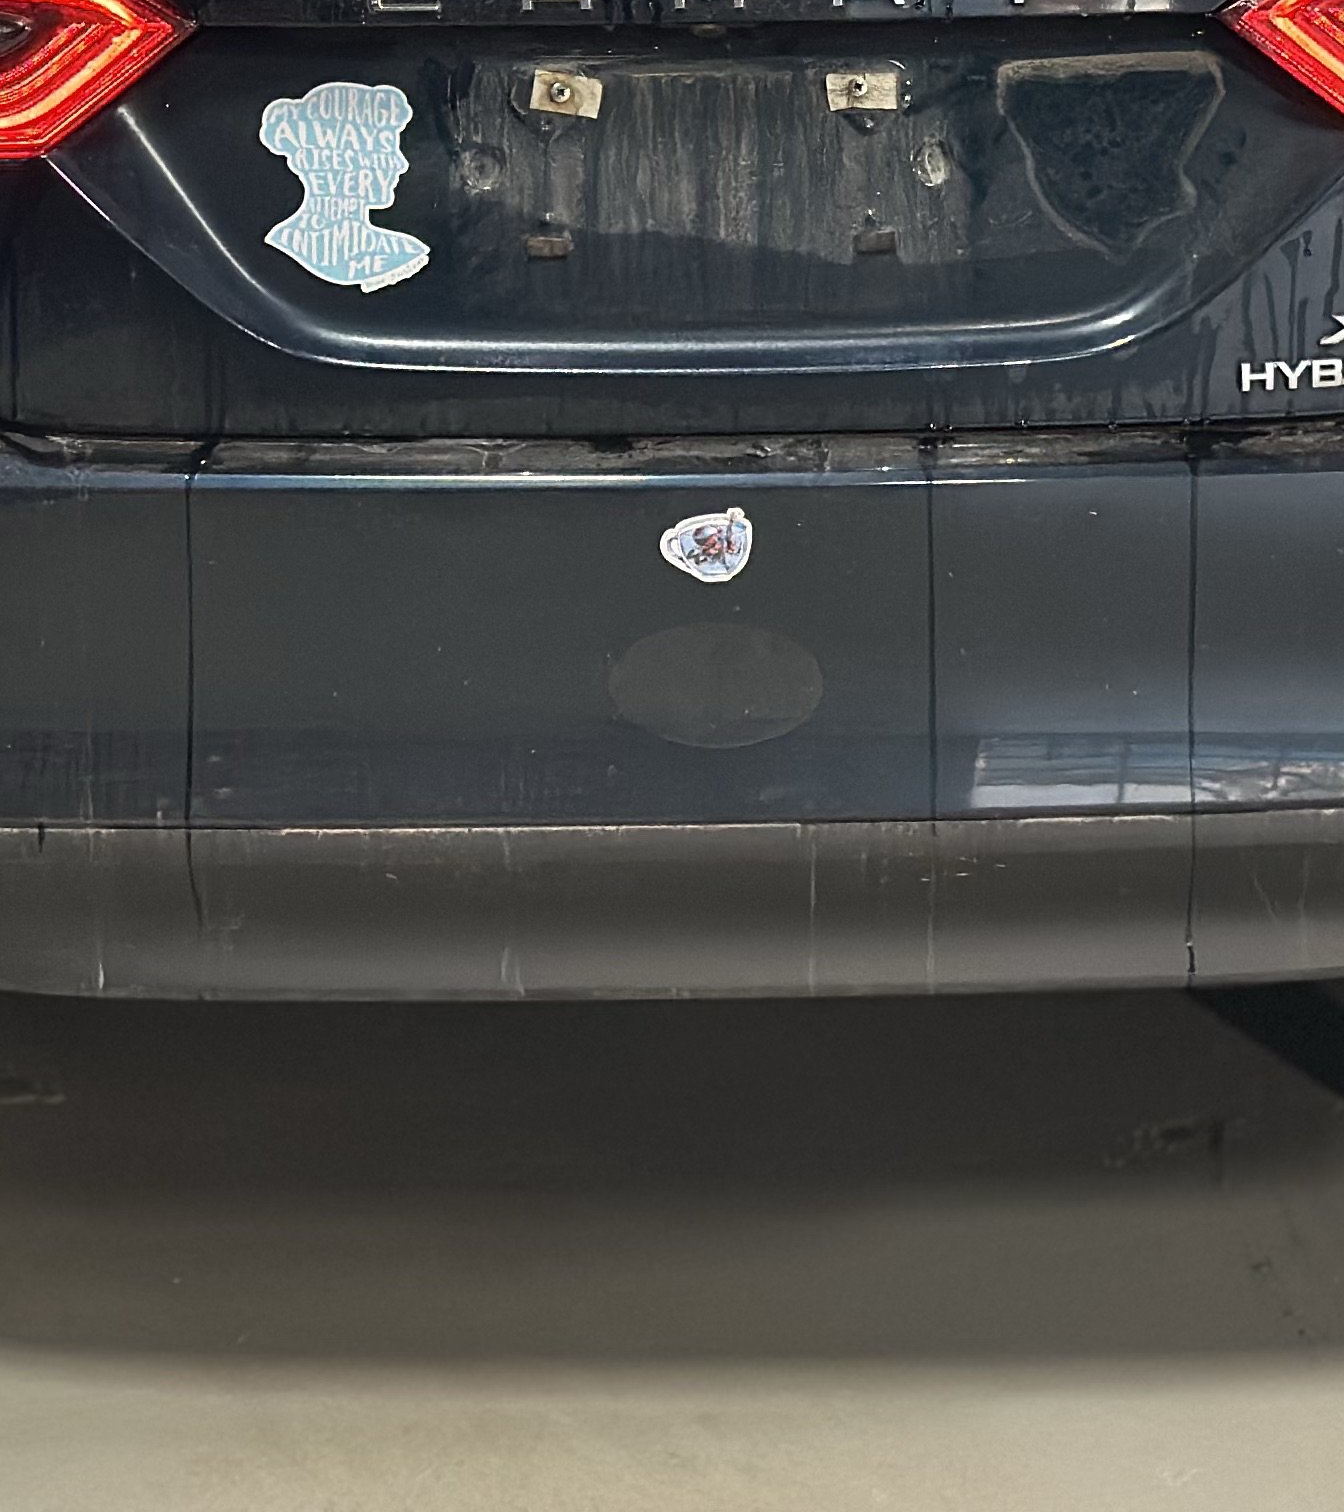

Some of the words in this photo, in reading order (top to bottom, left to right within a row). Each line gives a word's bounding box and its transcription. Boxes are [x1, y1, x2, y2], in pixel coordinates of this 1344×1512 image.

[270, 103, 299, 123] MY
[307, 89, 401, 126] COURAGE
[274, 120, 394, 152] ALWAYS
[295, 148, 354, 170] RISES
[358, 155, 402, 170] WITH
[309, 169, 394, 203] EVERY
[299, 213, 327, 229] TO
[306, 196, 366, 221] ATTEMPT
[280, 220, 418, 266] INTIMIDATE
[348, 255, 389, 279] ME
